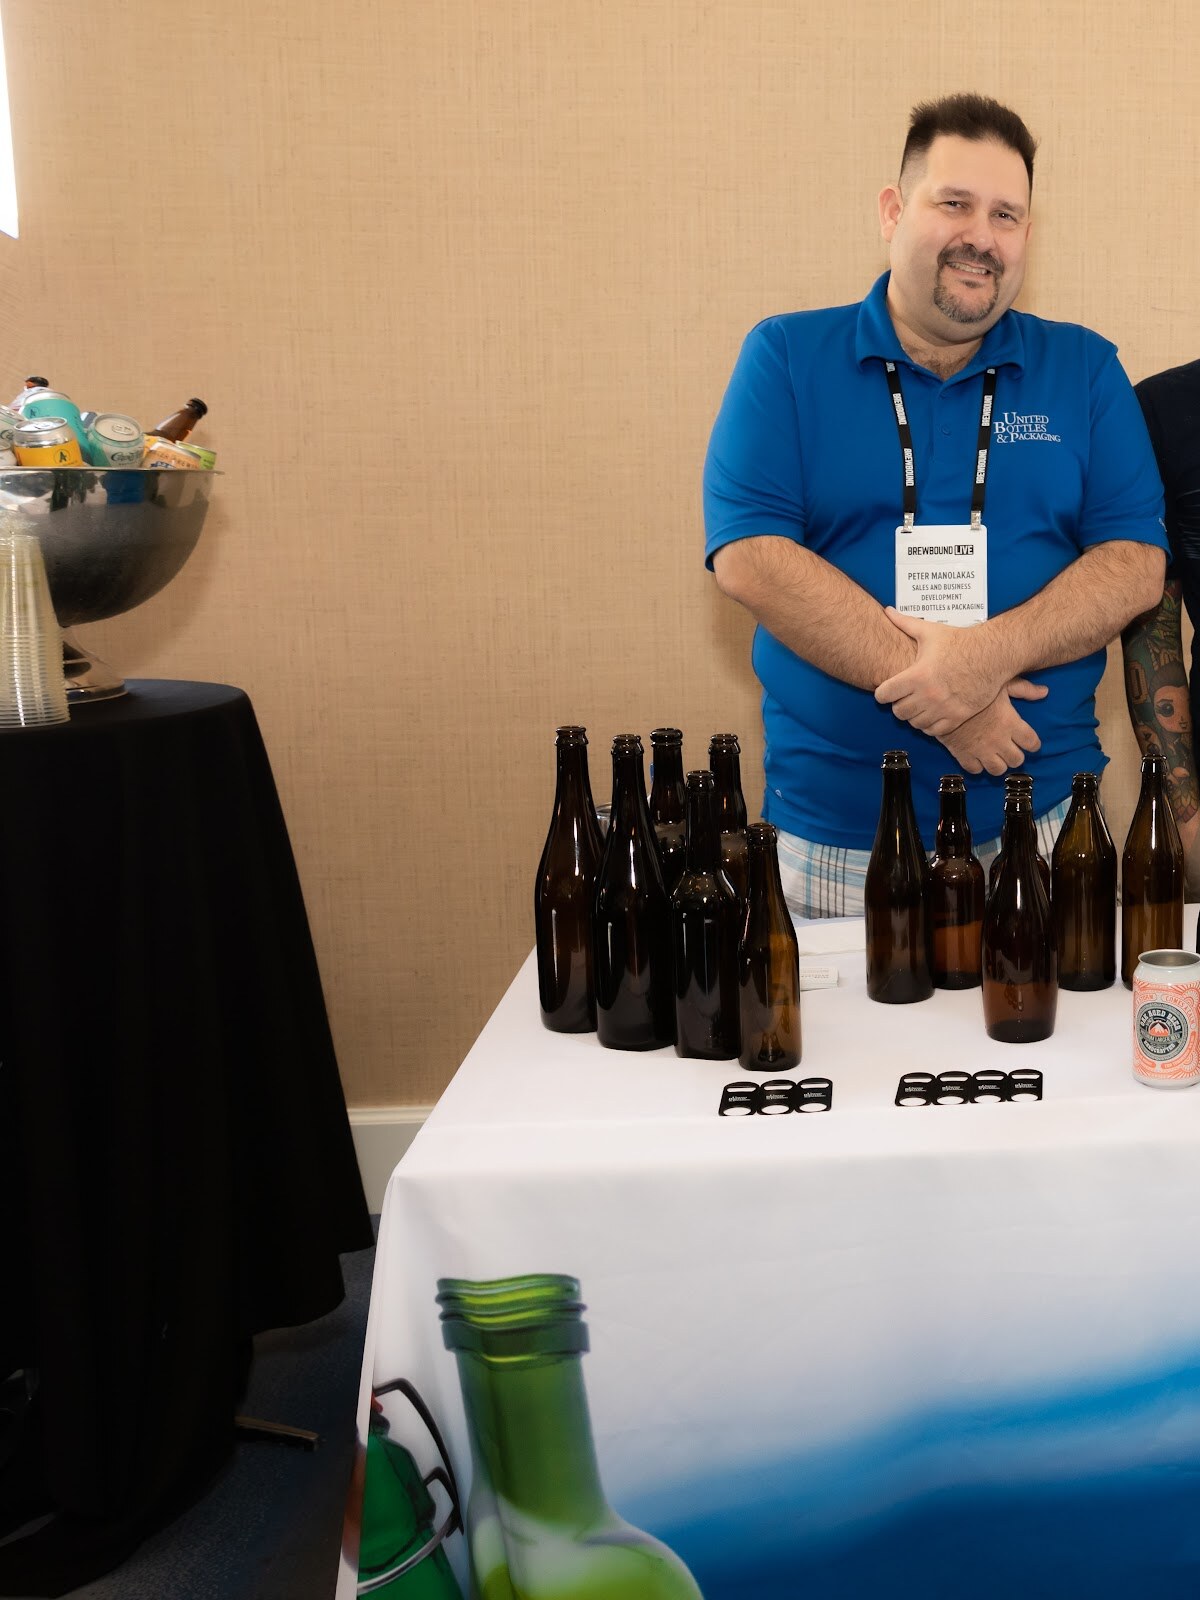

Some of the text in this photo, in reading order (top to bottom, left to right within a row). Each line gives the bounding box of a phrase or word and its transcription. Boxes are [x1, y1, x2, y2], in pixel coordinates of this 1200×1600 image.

[1003, 412, 1049, 425] UNITED
[993, 421, 1047, 434] BOTTLES
[996, 432, 1061, 444] & PACKAGING
[907, 545, 974, 556] BREWBOUND LIVE
[908, 571, 975, 581] PETER MANOLAKAS
[921, 593, 962, 601] DEVELOPMENT
